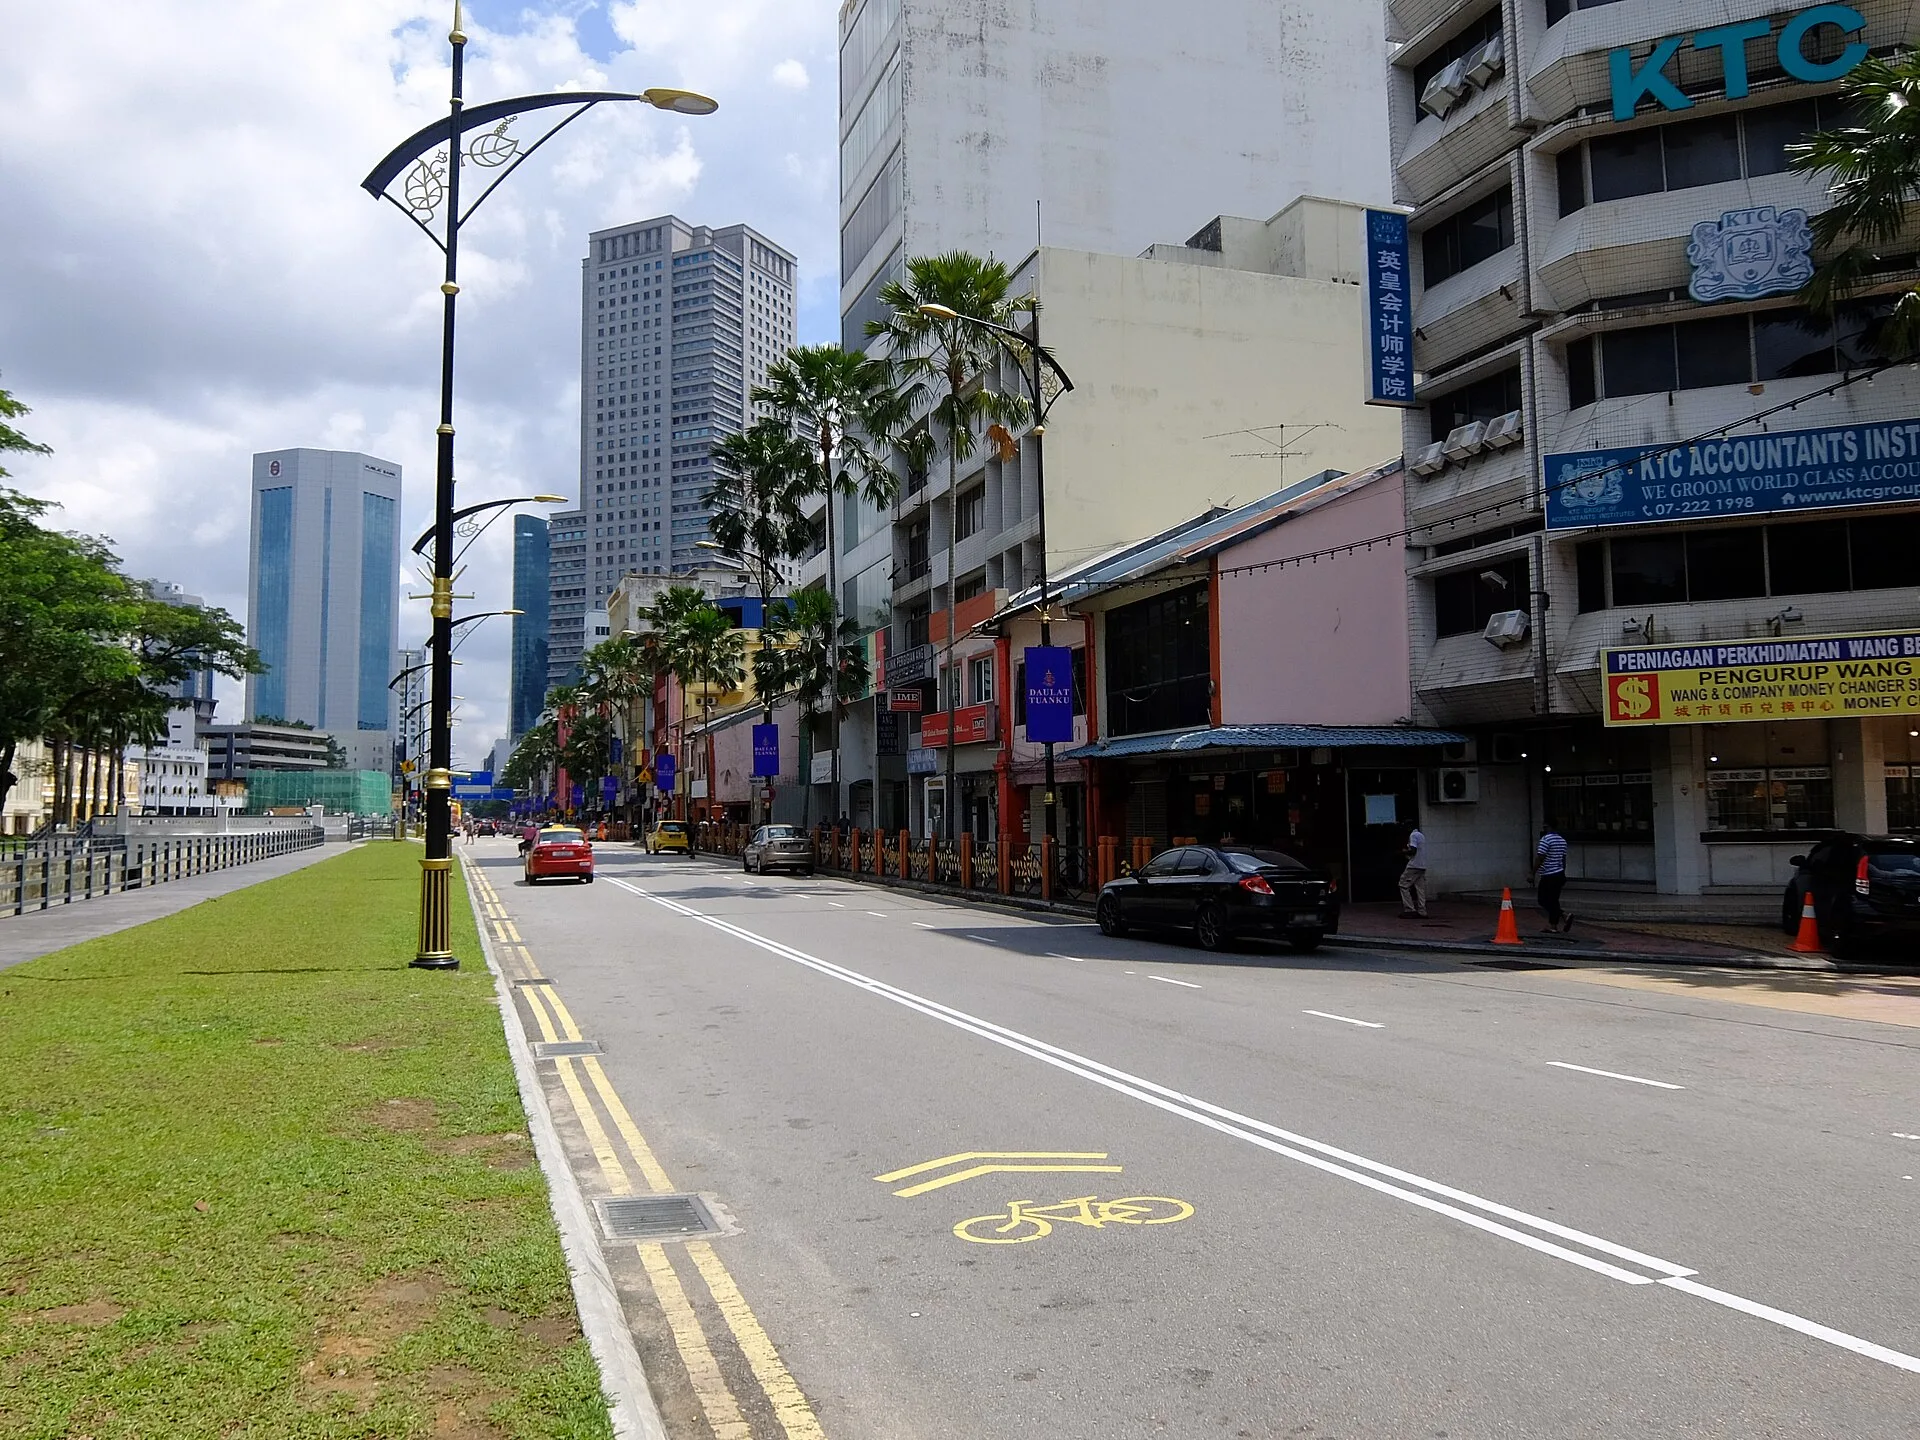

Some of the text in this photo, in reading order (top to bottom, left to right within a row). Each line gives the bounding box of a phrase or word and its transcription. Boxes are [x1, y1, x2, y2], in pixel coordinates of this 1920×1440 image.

[1608, 4, 1869, 122] KTC
[1723, 209, 1772, 228] KTC
[1377, 249, 1407, 397] 英皇会计师学院
[1640, 424, 1920, 481] KTC ACCOUNTANTS INST
[1641, 484, 1666, 500] WE
[1671, 481, 1732, 498] GROOM
[1736, 472, 1799, 492] WORLD
[1803, 467, 1855, 487] CLASS
[1551, 510, 1635, 522] ACCOUNTANTS INSTITUTES
[1655, 496, 1755, 516] 07-222 1998
[1618, 649, 1713, 671] PERNIAGAAN
[1717, 641, 1840, 665] PERKHIDMATAN
[1849, 638, 1899, 658] WANG
[1699, 660, 1912, 686] PENGURUP WANG
[1029, 688, 1070, 697] DAULAT
[1671, 688, 1708, 702] WANG
[1711, 688, 1720, 700] &
[1723, 684, 1785, 699] COMPANY
[1789, 682, 1835, 697] MONEY
[1839, 678, 1906, 695] CHANGER
[1844, 693, 1920, 709] MONEY C
[1673, 699, 1834, 717] 城市货币兑换中心
